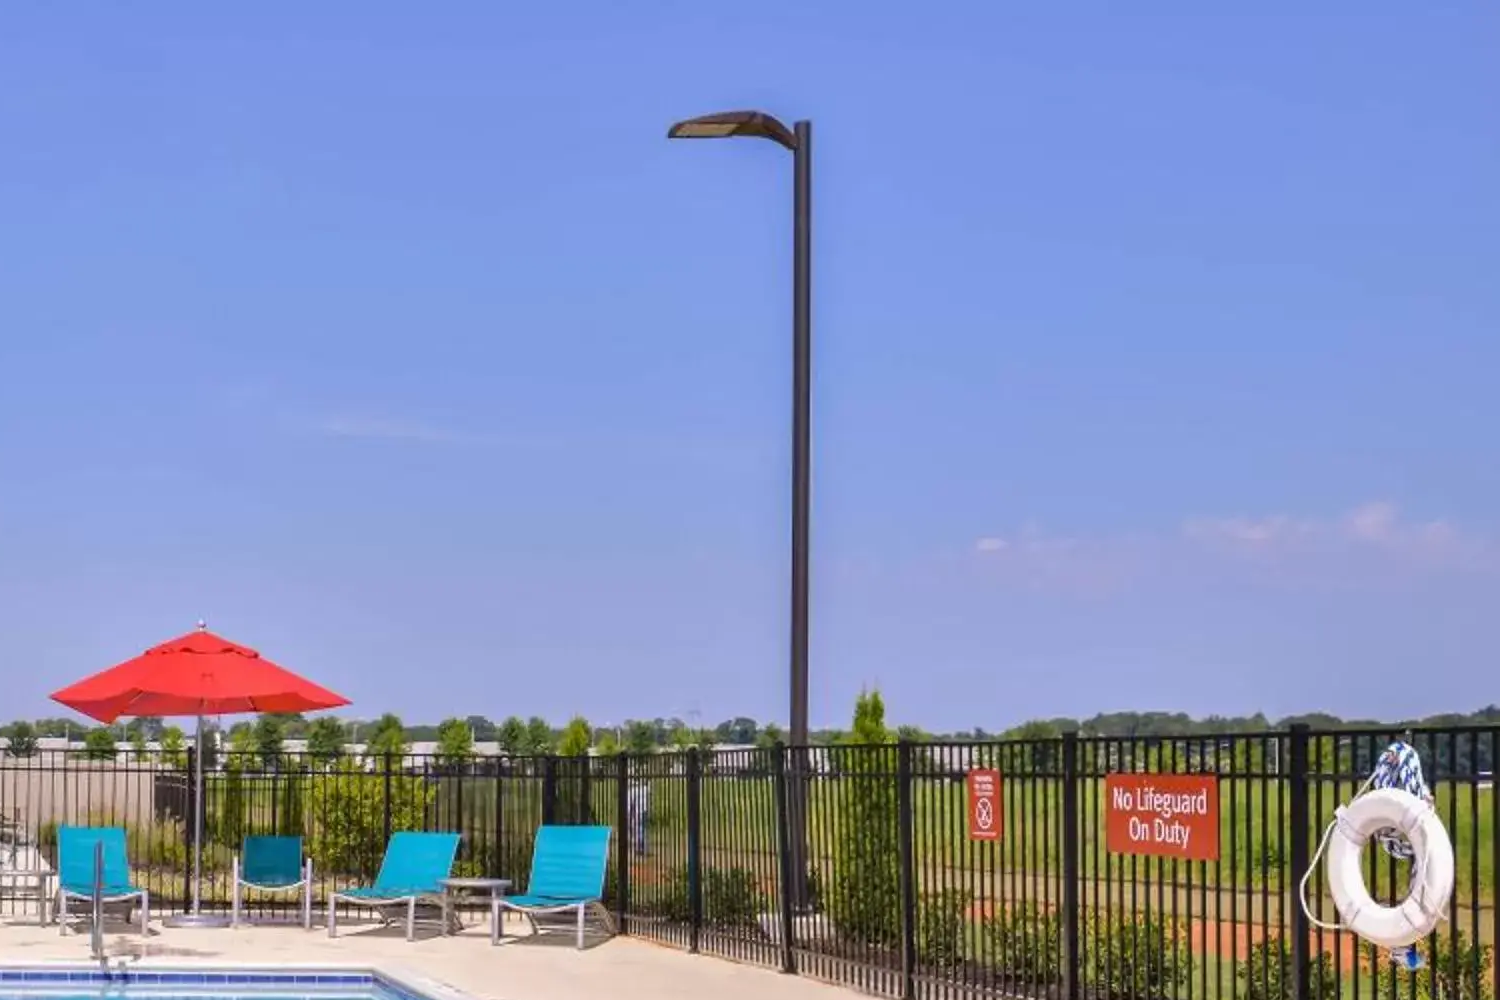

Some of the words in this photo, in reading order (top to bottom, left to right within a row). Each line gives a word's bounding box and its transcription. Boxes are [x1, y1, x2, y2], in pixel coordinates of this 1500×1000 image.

[1113, 787, 1133, 811] No
[1137, 786, 1208, 818] Lifeguard
[1128, 816, 1150, 841] On
[1154, 818, 1190, 849] Duty
